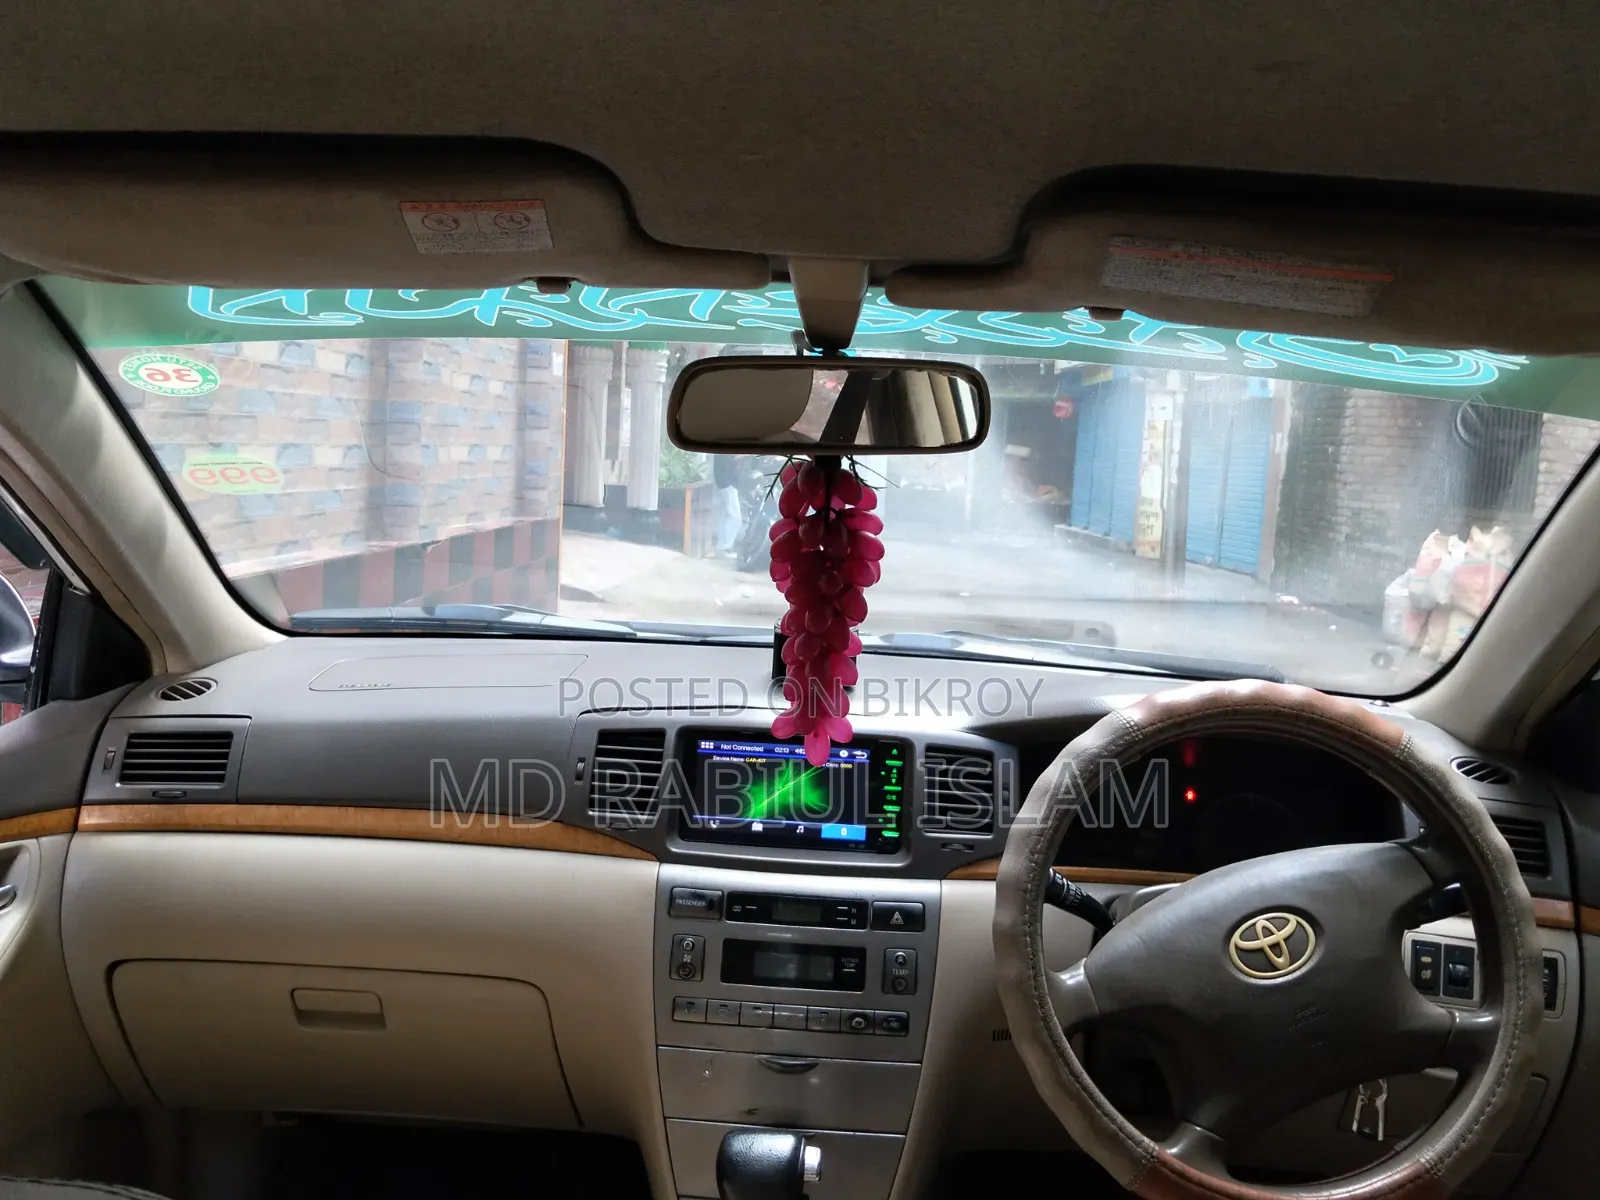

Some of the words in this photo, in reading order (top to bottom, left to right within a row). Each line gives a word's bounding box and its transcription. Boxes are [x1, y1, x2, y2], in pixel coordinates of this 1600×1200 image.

[733, 744, 764, 752] Connected
[675, 897, 706, 907] PASSENGER
[891, 968, 910, 976] TEMP
